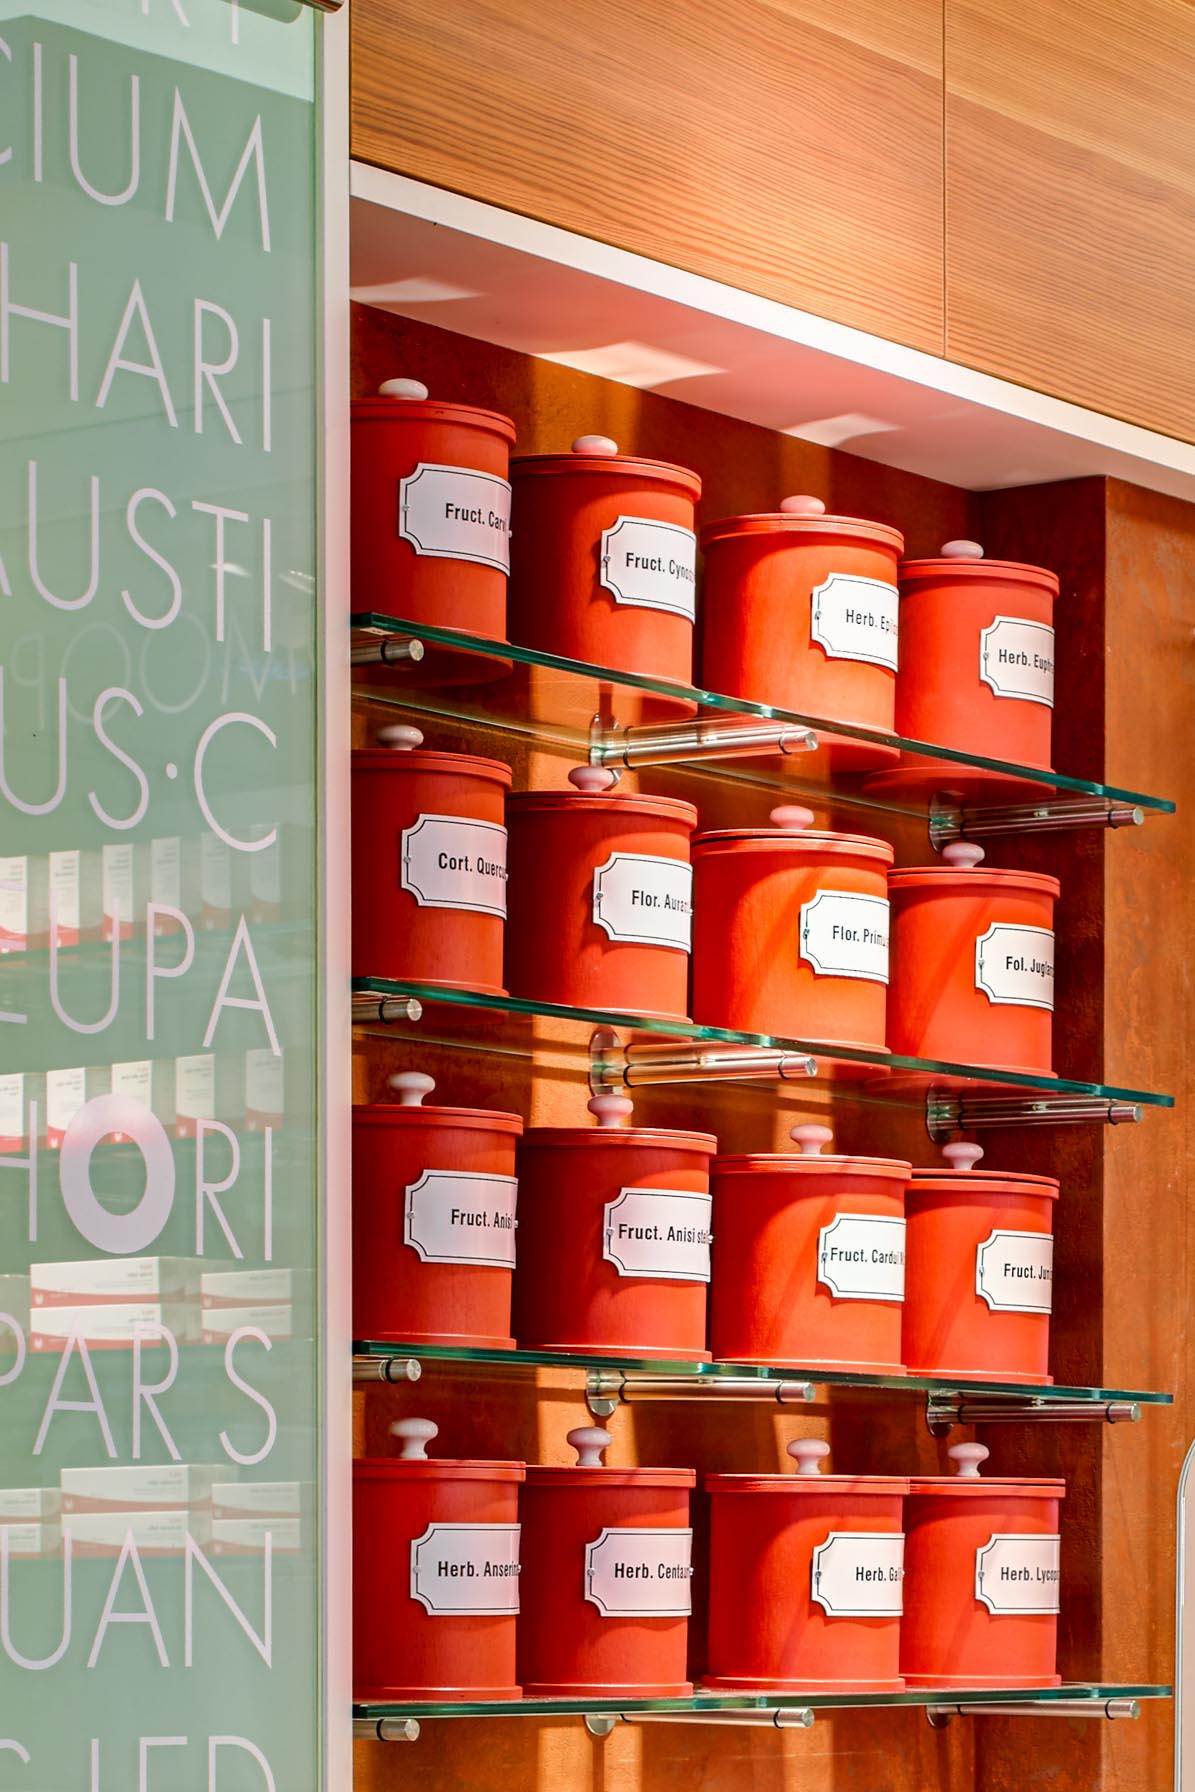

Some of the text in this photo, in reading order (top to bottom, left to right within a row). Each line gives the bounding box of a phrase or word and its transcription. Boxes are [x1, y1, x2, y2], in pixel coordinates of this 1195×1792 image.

[0, 37, 271, 253] IUM
[0, 241, 272, 452] HARI
[445, 503, 485, 525] Fruct.
[0, 460, 272, 653] USTI
[626, 552, 665, 572] Fruct.
[846, 608, 878, 629] Herb.
[999, 648, 1031, 666] Herb.
[438, 852, 473, 872] Cort.
[632, 890, 660, 908] Flor.
[831, 925, 858, 942] Flor.
[1006, 956, 1028, 972] Fol.
[450, 1208, 489, 1227] Fruct.
[618, 1223, 662, 1241] Fruct.
[667, 1226, 694, 1243] Anisi
[830, 1247, 868, 1263] Fruct.
[1004, 1263, 1036, 1279] Fruct.
[437, 1560, 479, 1577] Herb.
[614, 1562, 653, 1579] Herb.
[855, 1566, 886, 1582] Herb.
[1001, 1566, 1033, 1581] Herb.
